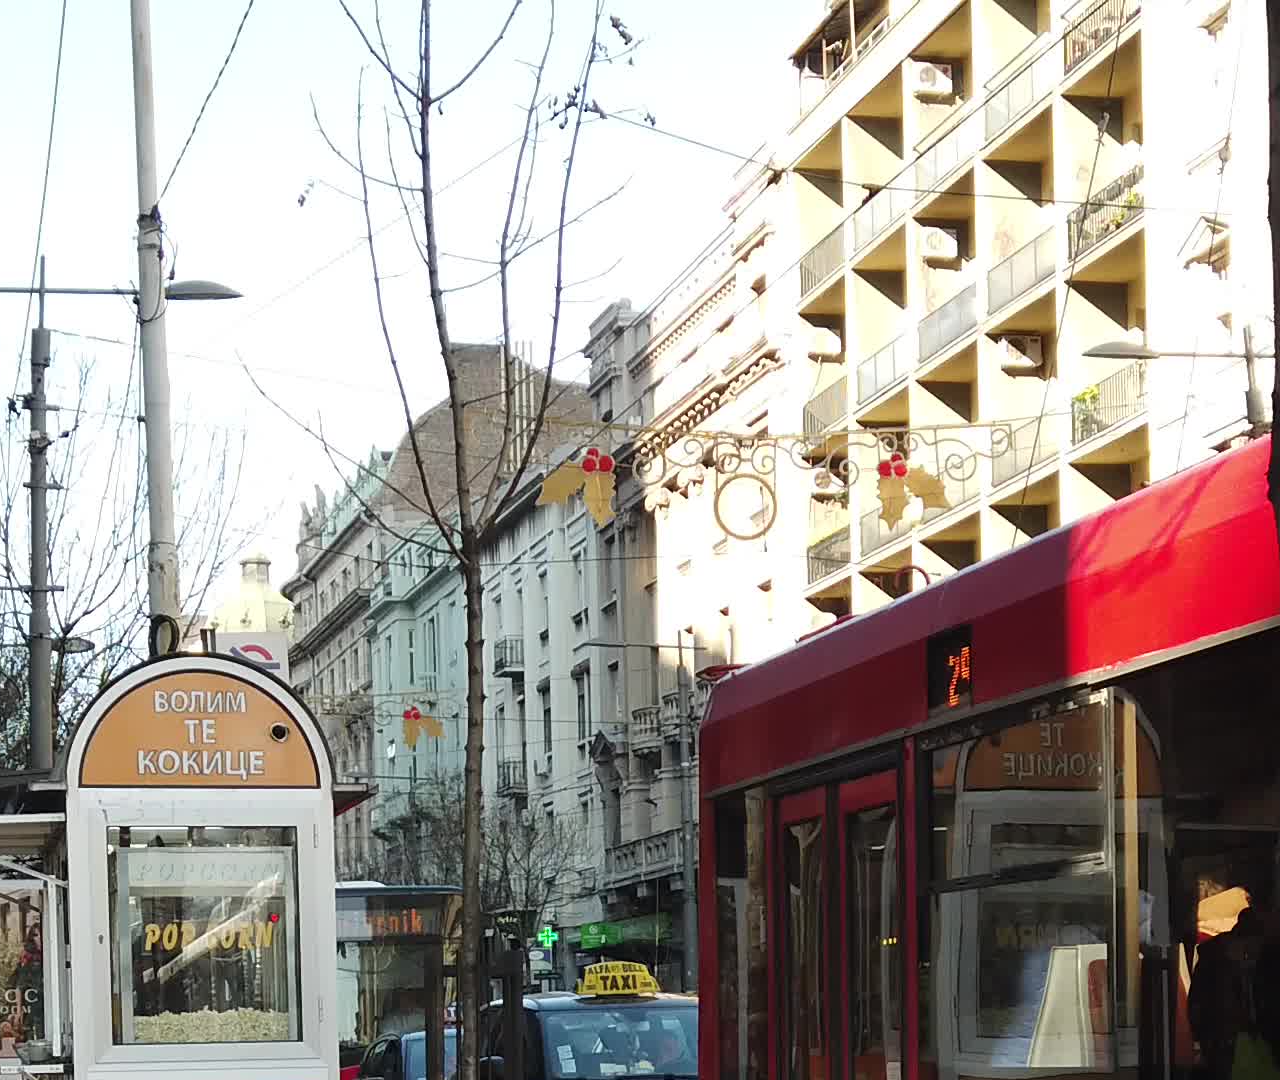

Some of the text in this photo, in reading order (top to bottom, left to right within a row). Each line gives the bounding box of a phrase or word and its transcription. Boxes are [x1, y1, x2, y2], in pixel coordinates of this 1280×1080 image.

[154, 690, 247, 713] ВОЛИМ
[184, 719, 216, 744] ТЕ
[137, 749, 265, 780] КОКИЦЕ
[600, 975, 637, 991] TAXI
